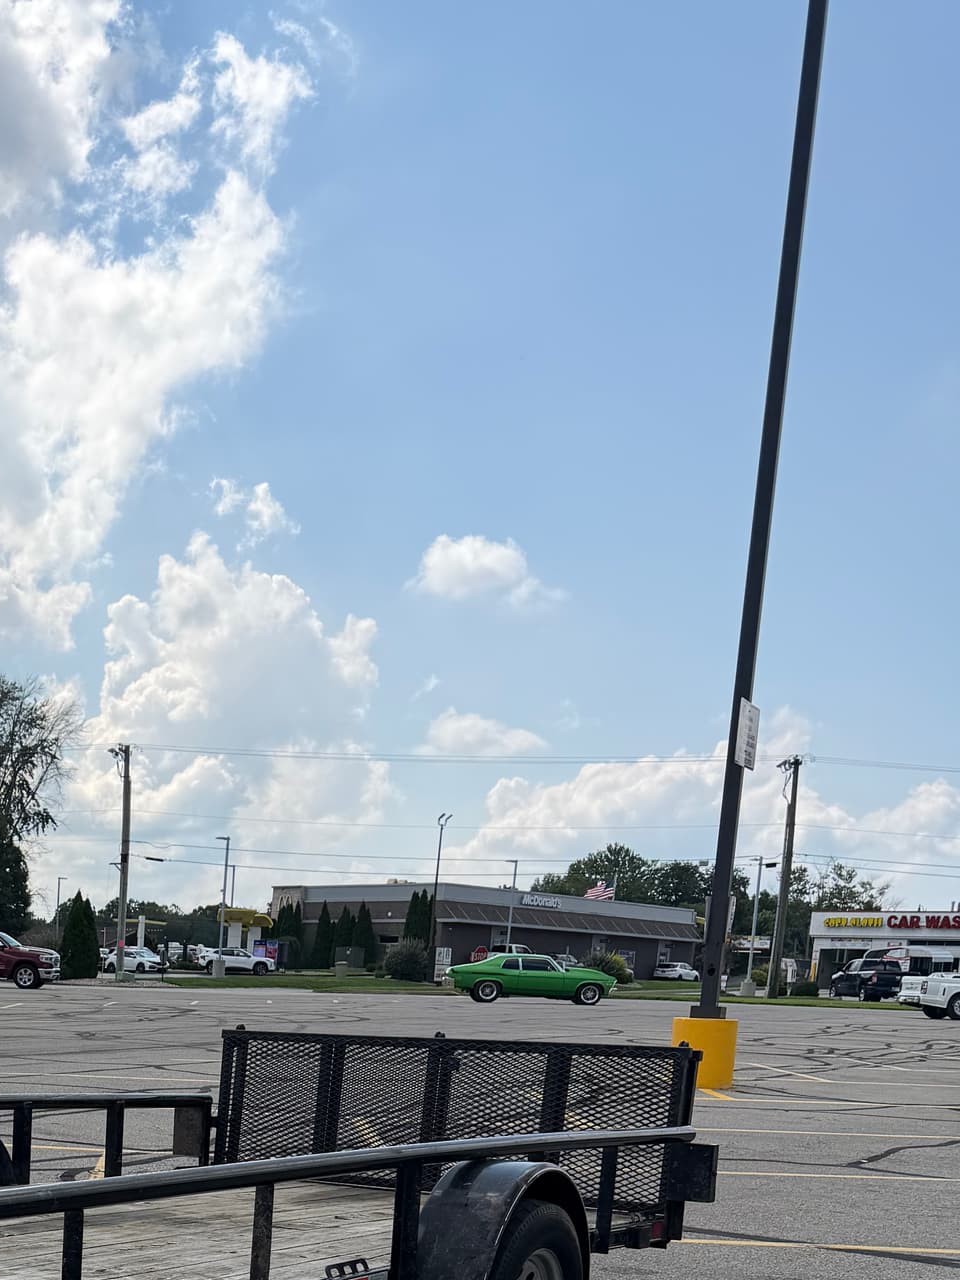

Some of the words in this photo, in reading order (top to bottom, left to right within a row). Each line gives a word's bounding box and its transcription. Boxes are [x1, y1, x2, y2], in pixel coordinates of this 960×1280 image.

[522, 894, 562, 909] McDonald's
[887, 915, 920, 929] CAR
[473, 952, 487, 961] STOP
